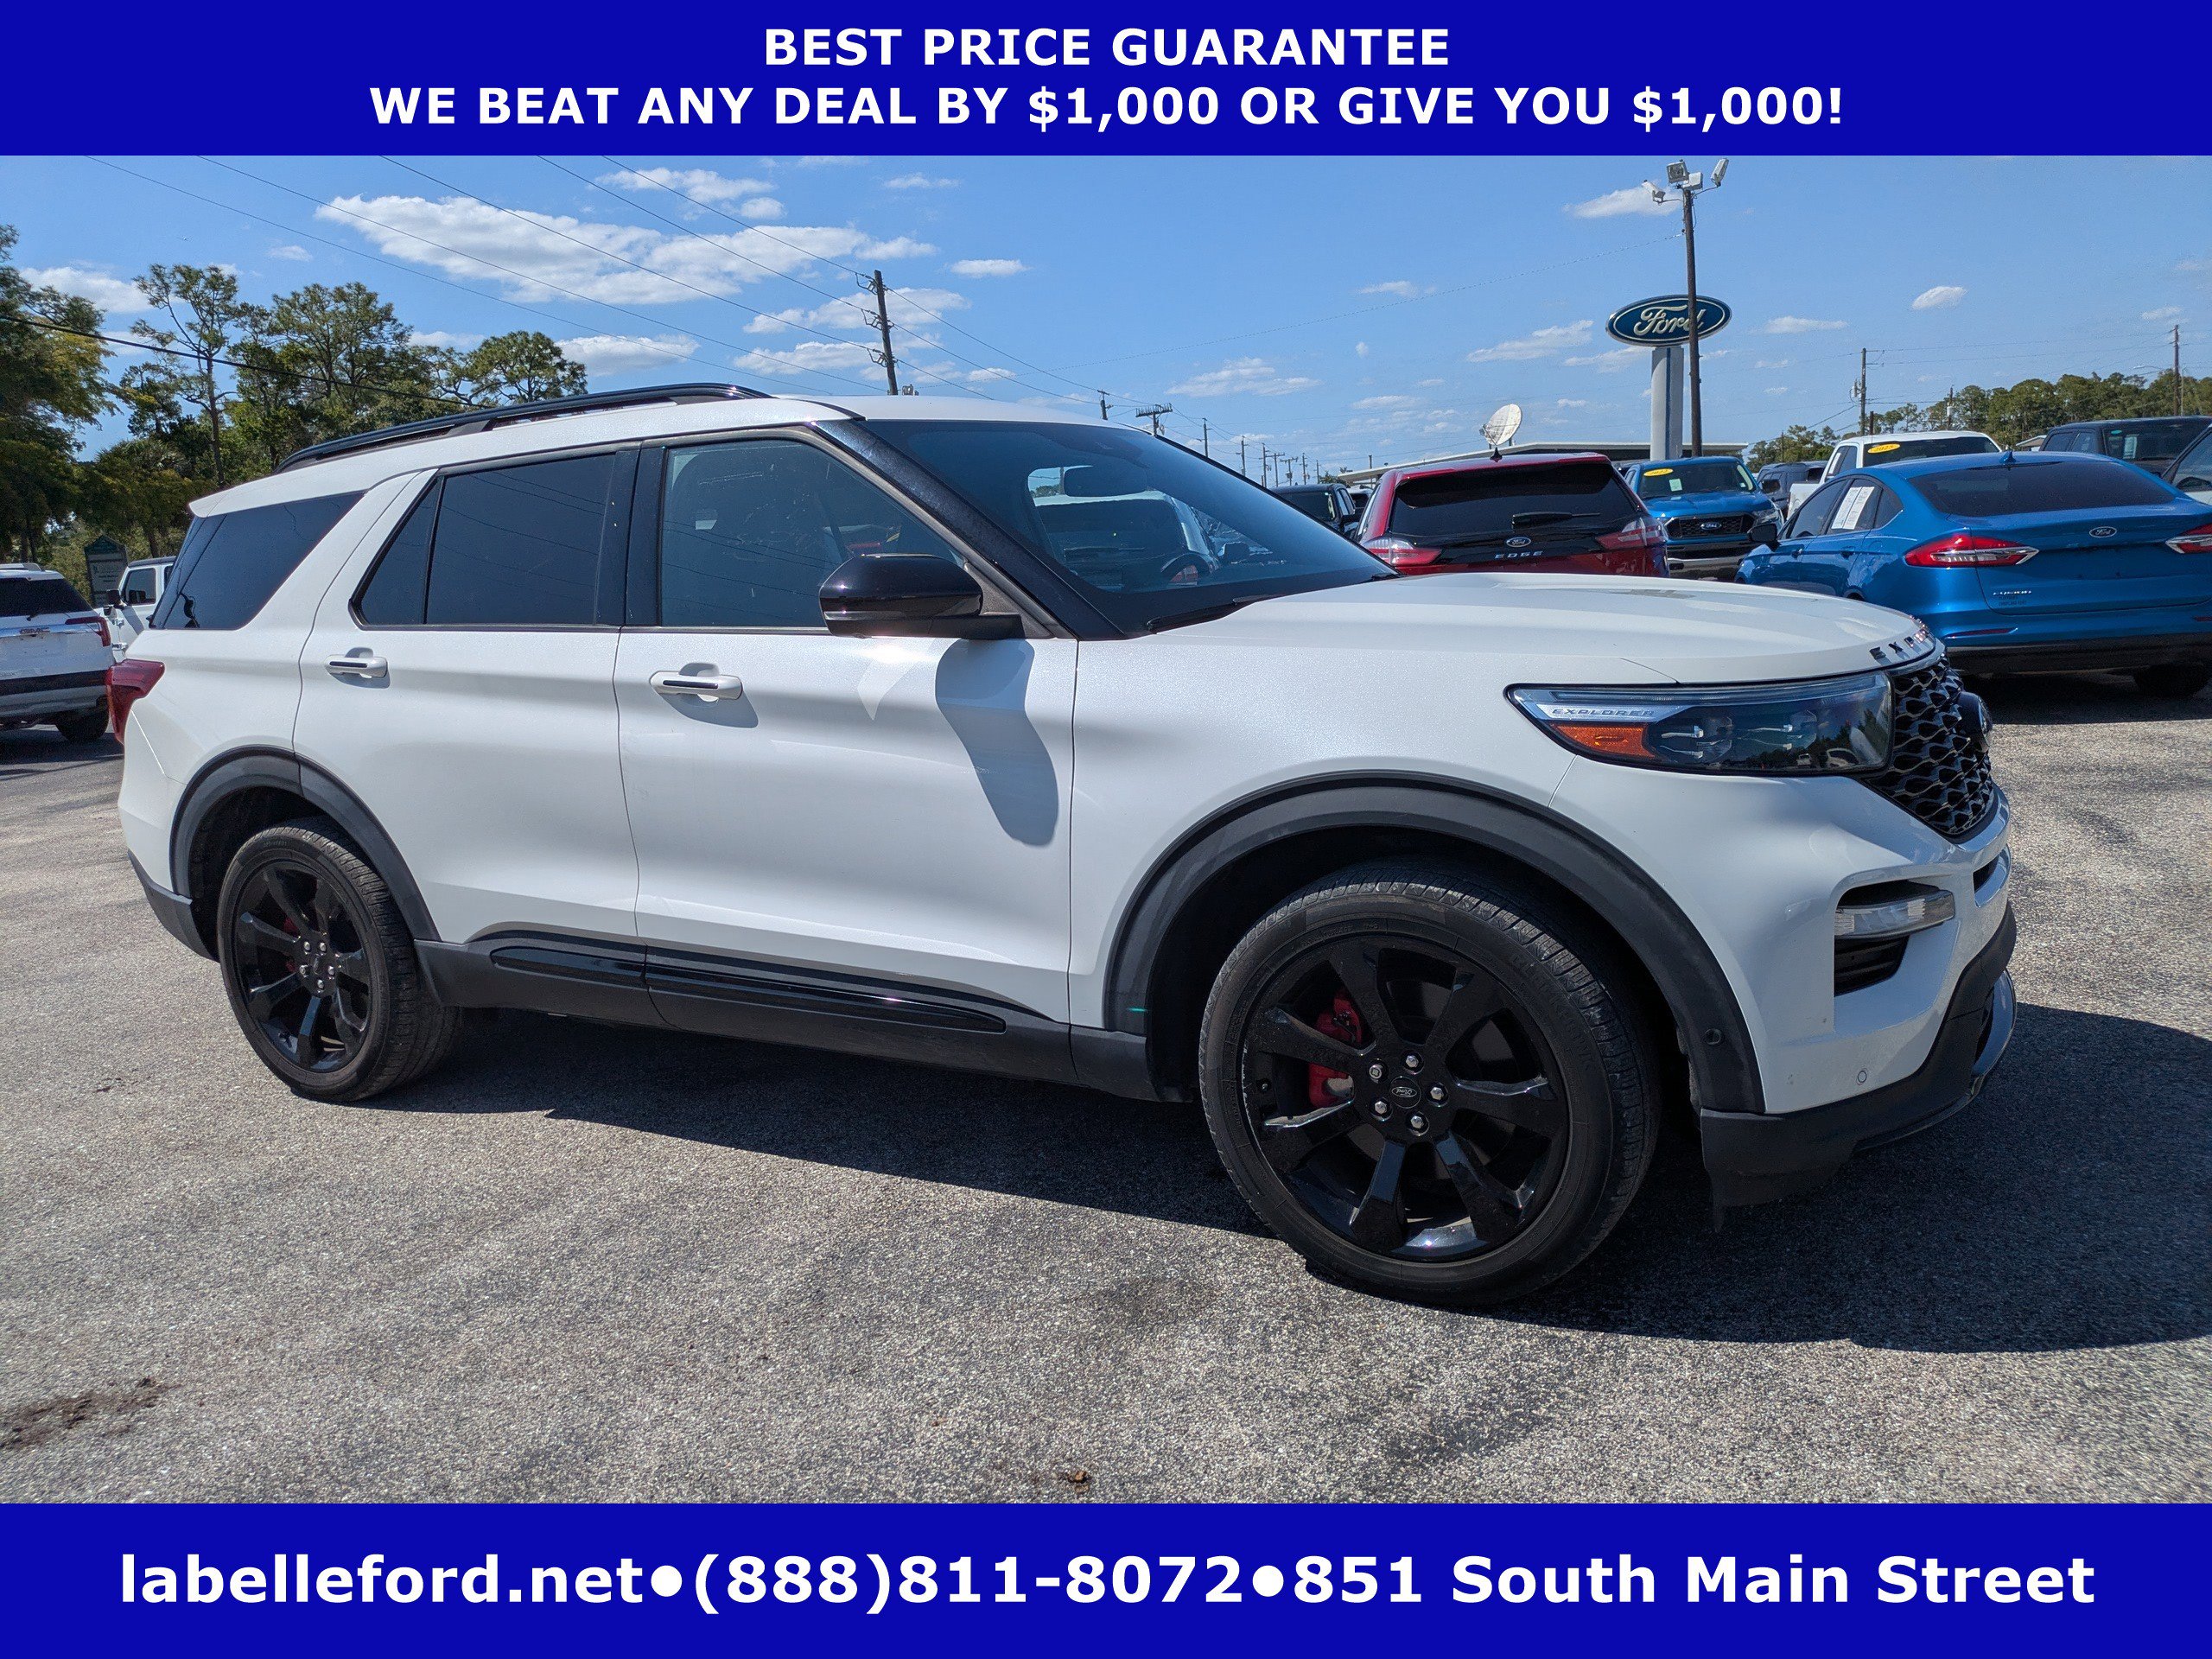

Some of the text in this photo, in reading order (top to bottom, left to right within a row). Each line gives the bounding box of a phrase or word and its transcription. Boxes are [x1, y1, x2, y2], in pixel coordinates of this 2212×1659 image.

[1633, 304, 1707, 336] Ford
[1495, 550, 1543, 559] EDGE
[1552, 708, 1654, 717] EXPLORER
